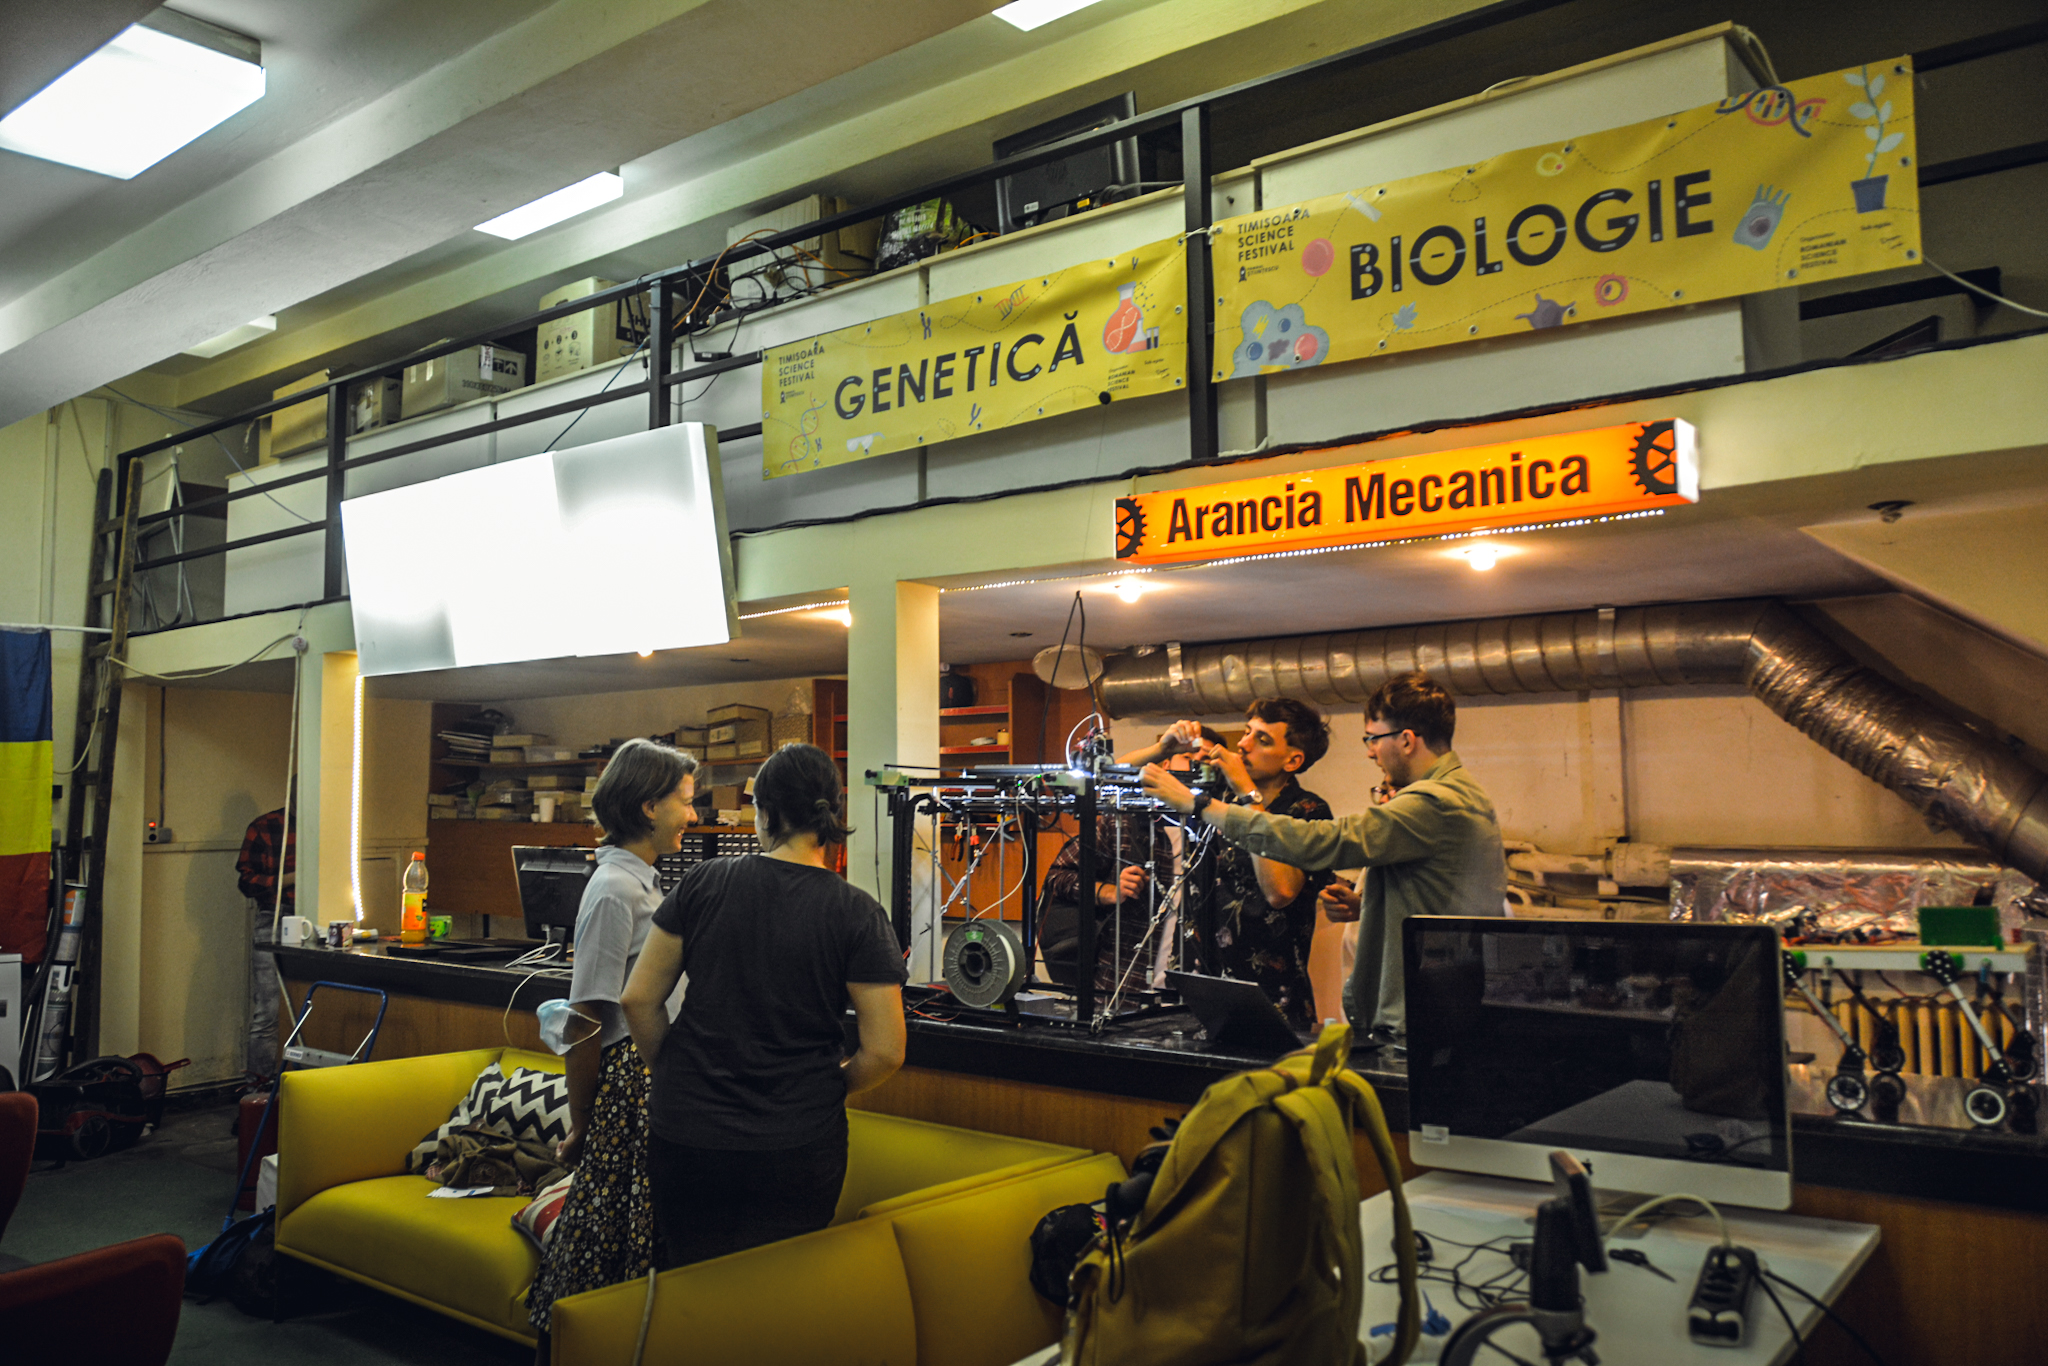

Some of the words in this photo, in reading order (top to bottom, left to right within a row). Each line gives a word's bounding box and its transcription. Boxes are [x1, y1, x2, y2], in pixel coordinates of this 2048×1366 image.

[1238, 225, 1294, 248] SCIENCE
[1350, 169, 1714, 301] BIOLOGIE
[1238, 240, 1295, 262] FESTIVAL
[779, 359, 814, 377] SCIENCE
[834, 310, 1085, 420] GENETICĂ
[779, 371, 815, 387] FESTIVAL
[1167, 482, 1322, 543] Arancia
[1345, 451, 1591, 524] Mecanica
